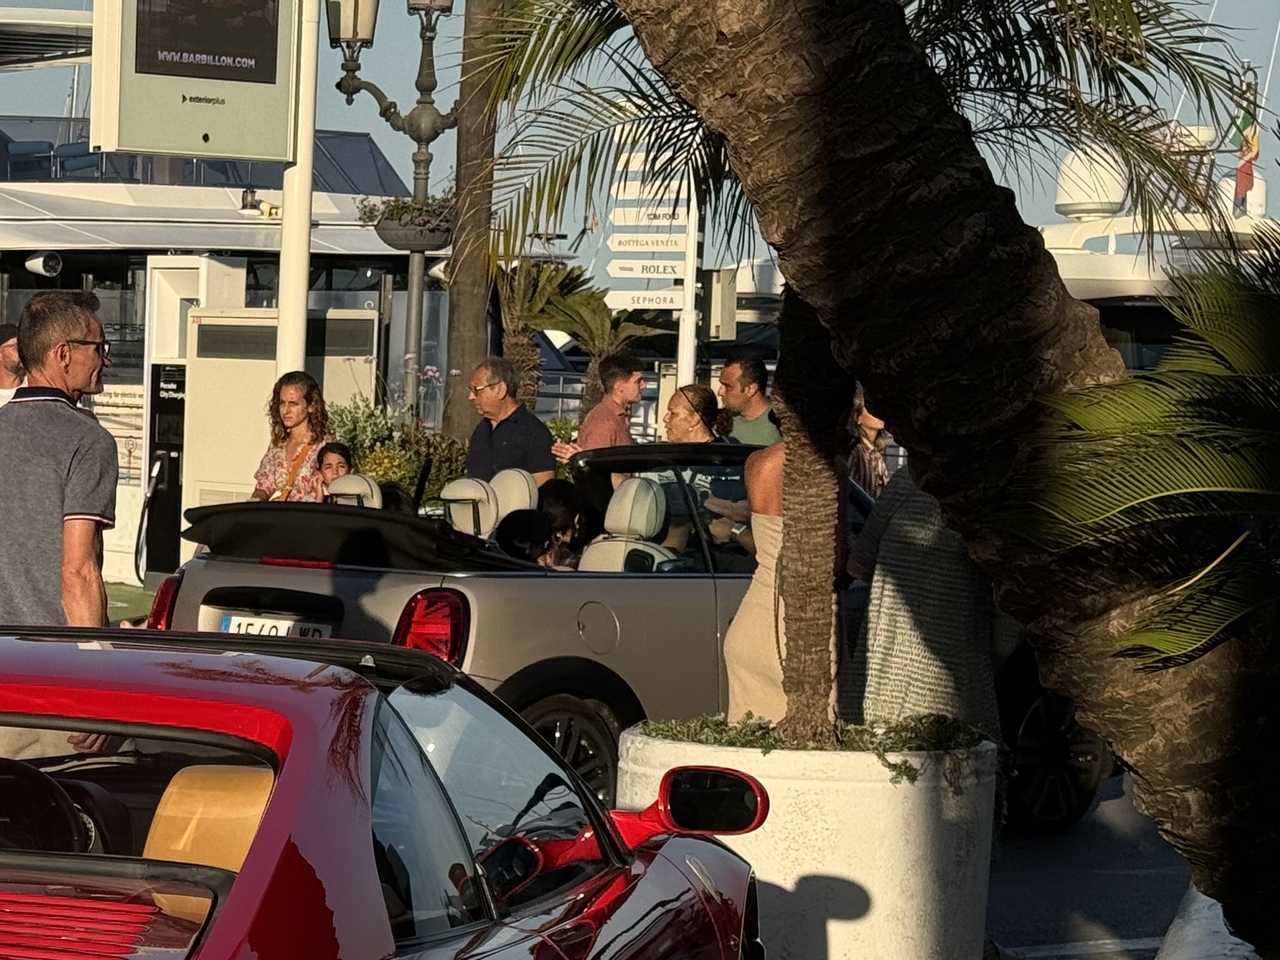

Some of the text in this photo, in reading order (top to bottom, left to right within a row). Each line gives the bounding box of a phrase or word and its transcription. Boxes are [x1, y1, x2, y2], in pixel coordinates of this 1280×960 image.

[157, 50, 256, 69] WWW.BARBILLON.COM
[189, 95, 226, 106] exteriorplus
[641, 265, 677, 274] ROLEX
[631, 296, 675, 305] SEPHORA
